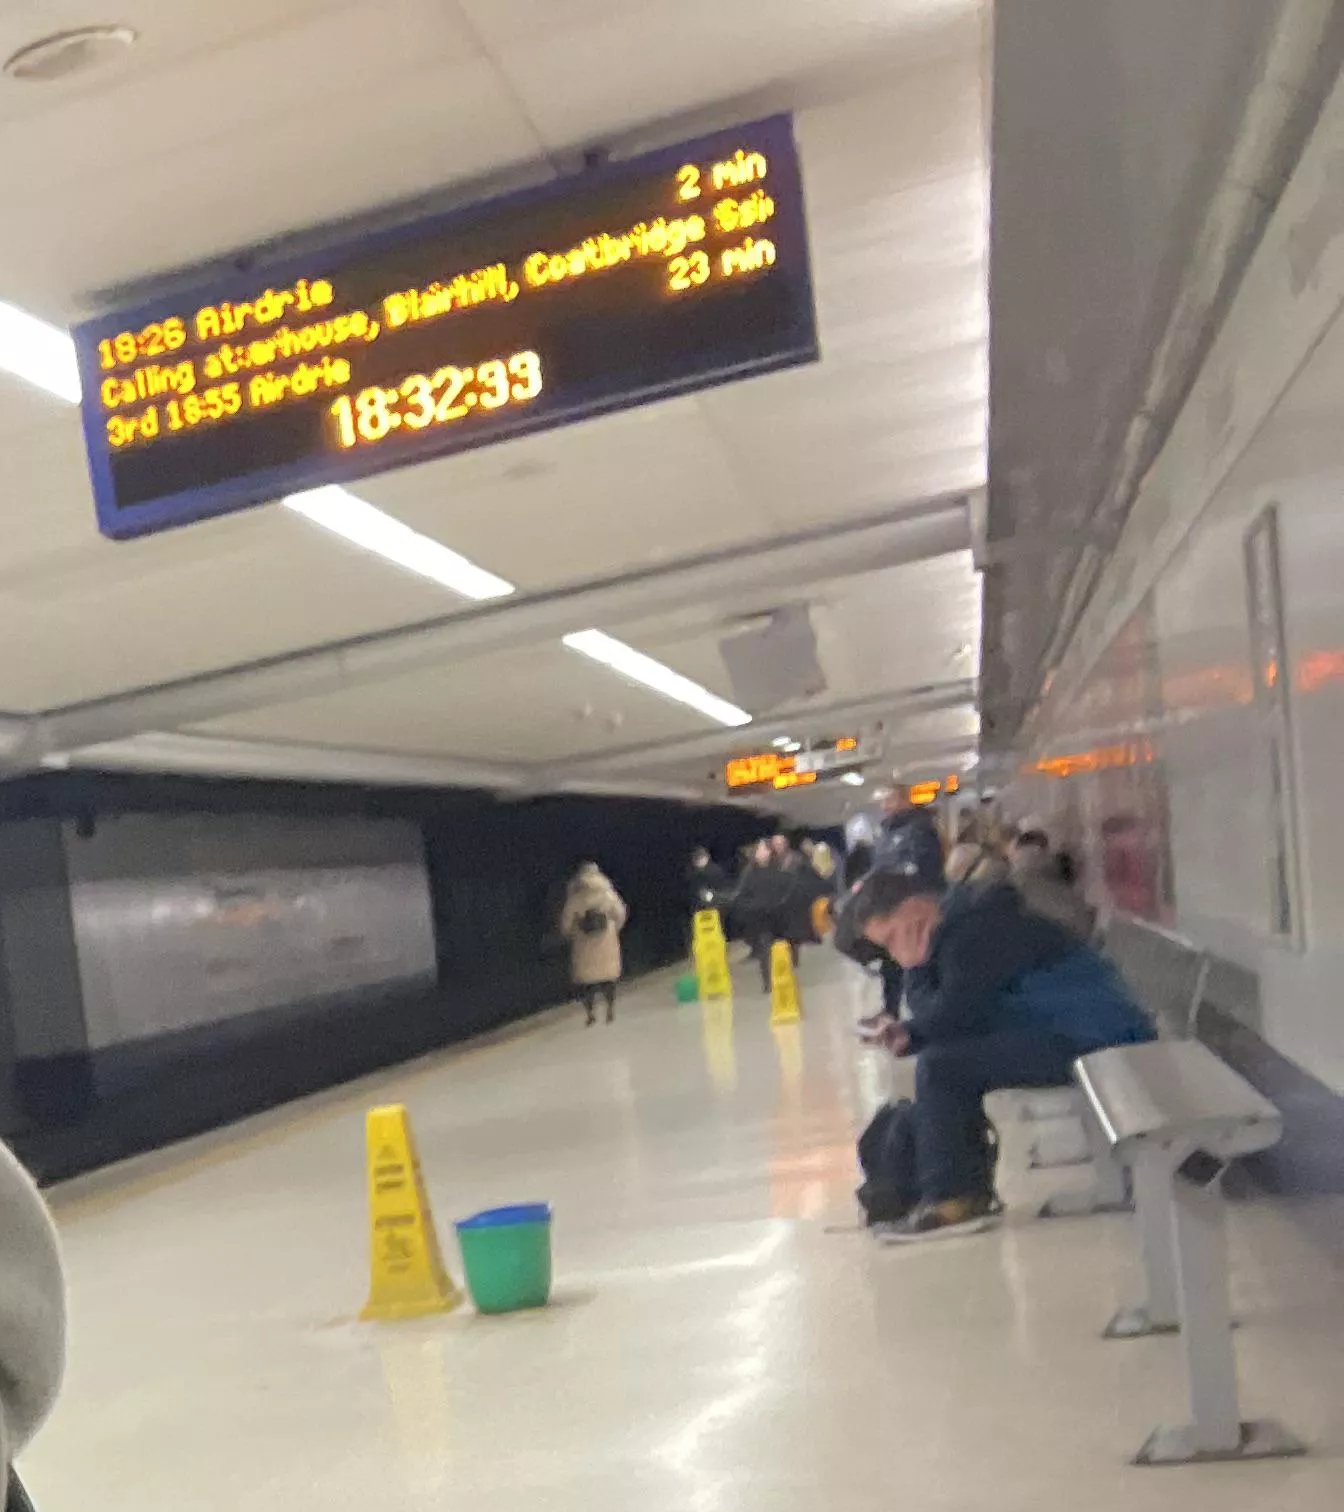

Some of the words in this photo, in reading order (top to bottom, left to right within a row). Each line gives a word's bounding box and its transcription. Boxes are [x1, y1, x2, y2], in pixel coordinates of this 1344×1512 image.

[98, 317, 187, 370] 18:26
[196, 279, 333, 341] Airdrie
[677, 164, 702, 202] 2
[712, 149, 767, 190] min
[106, 405, 159, 447] 3rd
[166, 381, 243, 431] 18:55
[248, 355, 351, 407] Airdrie
[667, 250, 711, 291] 23
[721, 236, 776, 277] min
[101, 360, 196, 409] Calling
